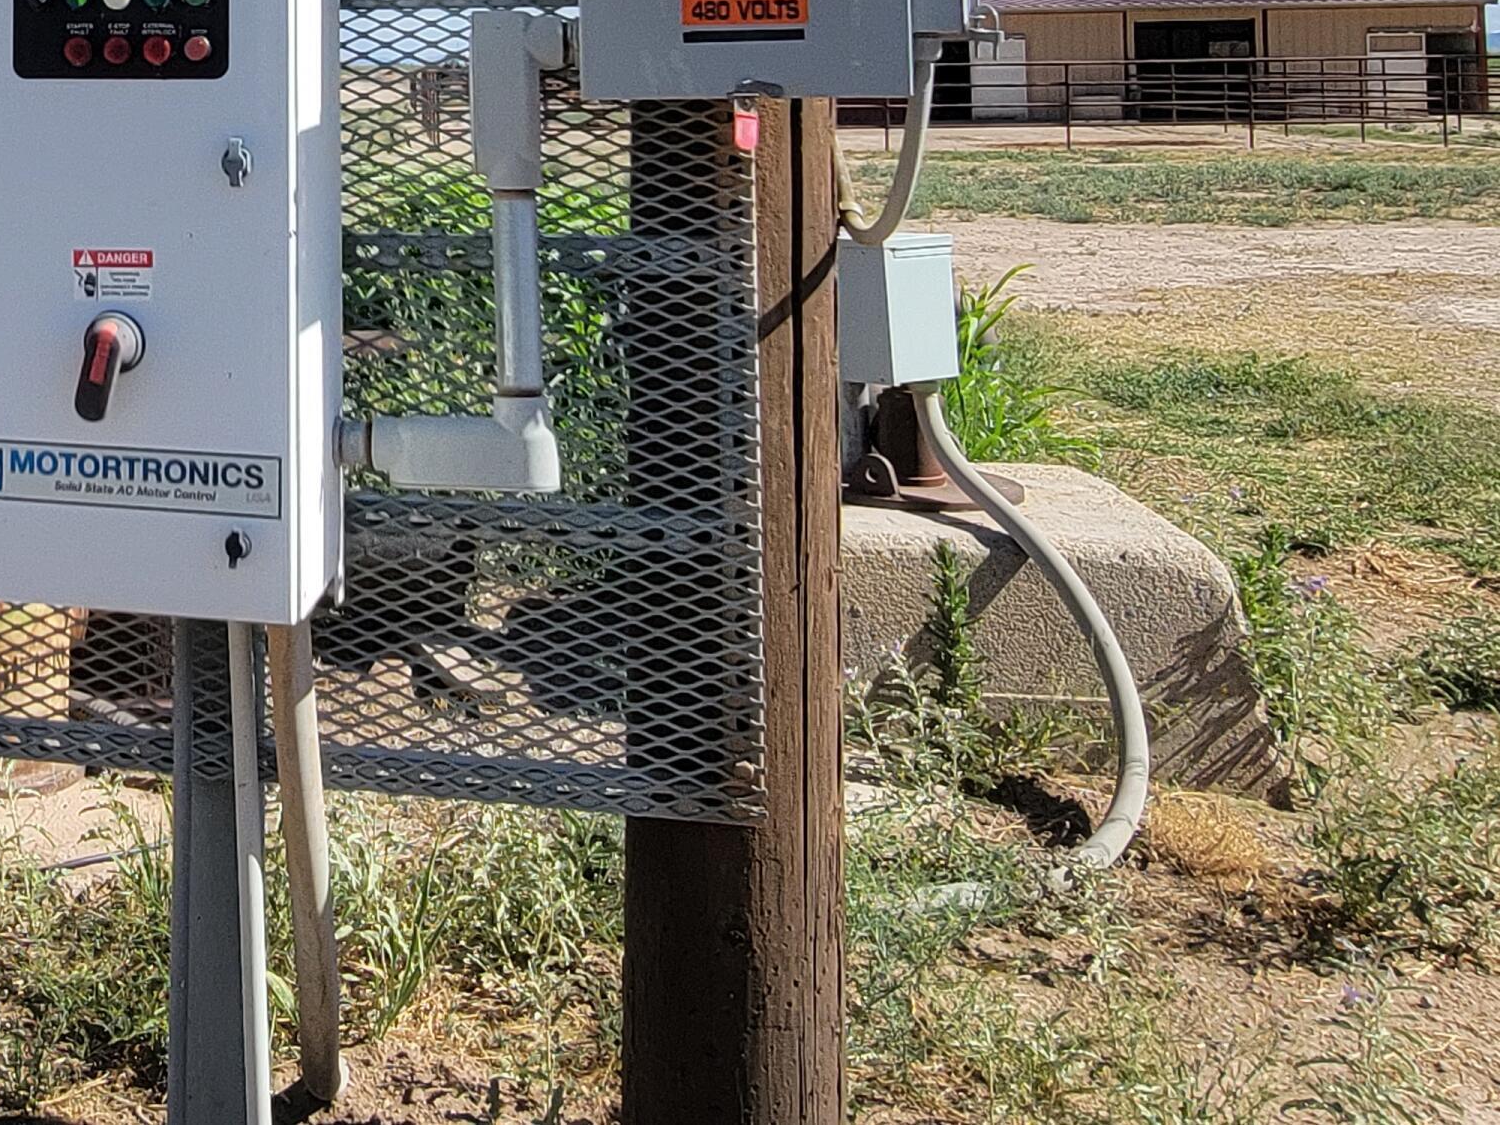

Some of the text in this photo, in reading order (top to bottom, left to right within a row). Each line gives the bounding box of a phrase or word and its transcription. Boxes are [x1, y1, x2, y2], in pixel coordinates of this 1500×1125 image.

[691, 0, 800, 21] 480 VOLTS
[97, 252, 148, 264] DANGER
[9, 449, 265, 490] MOTORTRONICS
[54, 480, 218, 502] Solid State AC Motor Control
